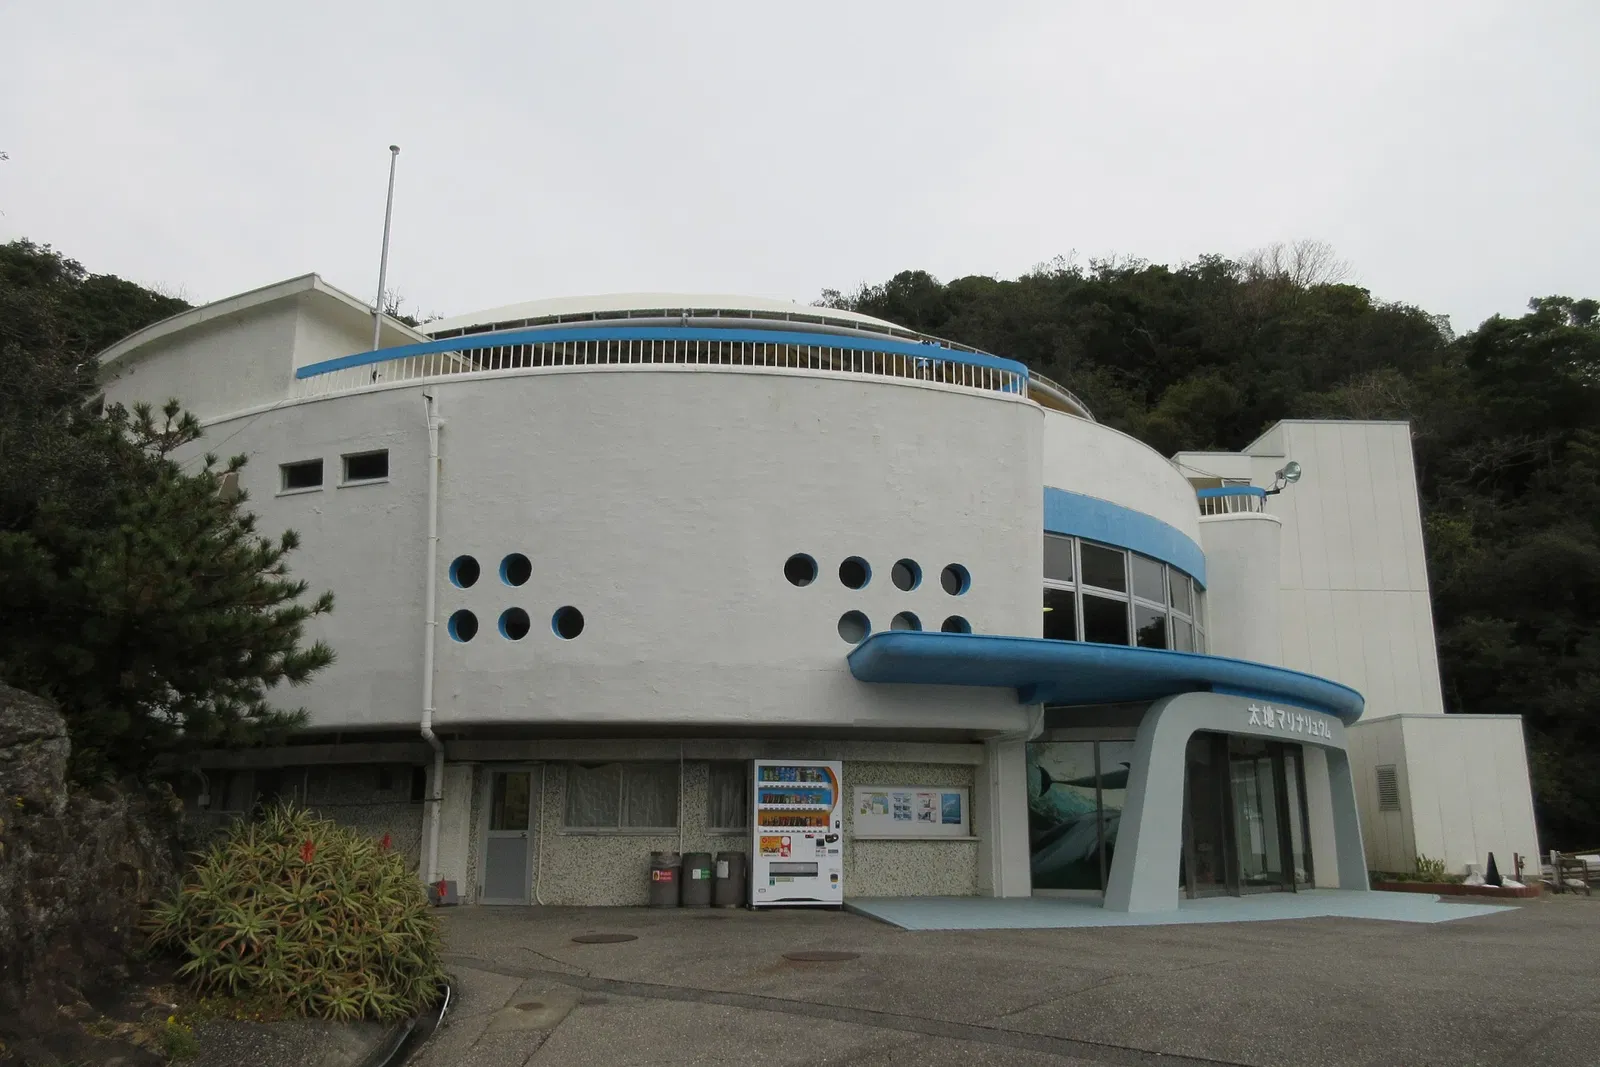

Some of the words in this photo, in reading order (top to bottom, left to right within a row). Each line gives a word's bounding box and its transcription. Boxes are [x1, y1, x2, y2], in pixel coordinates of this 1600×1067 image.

[1247, 703, 1332, 740] 太地マリナリュウム
